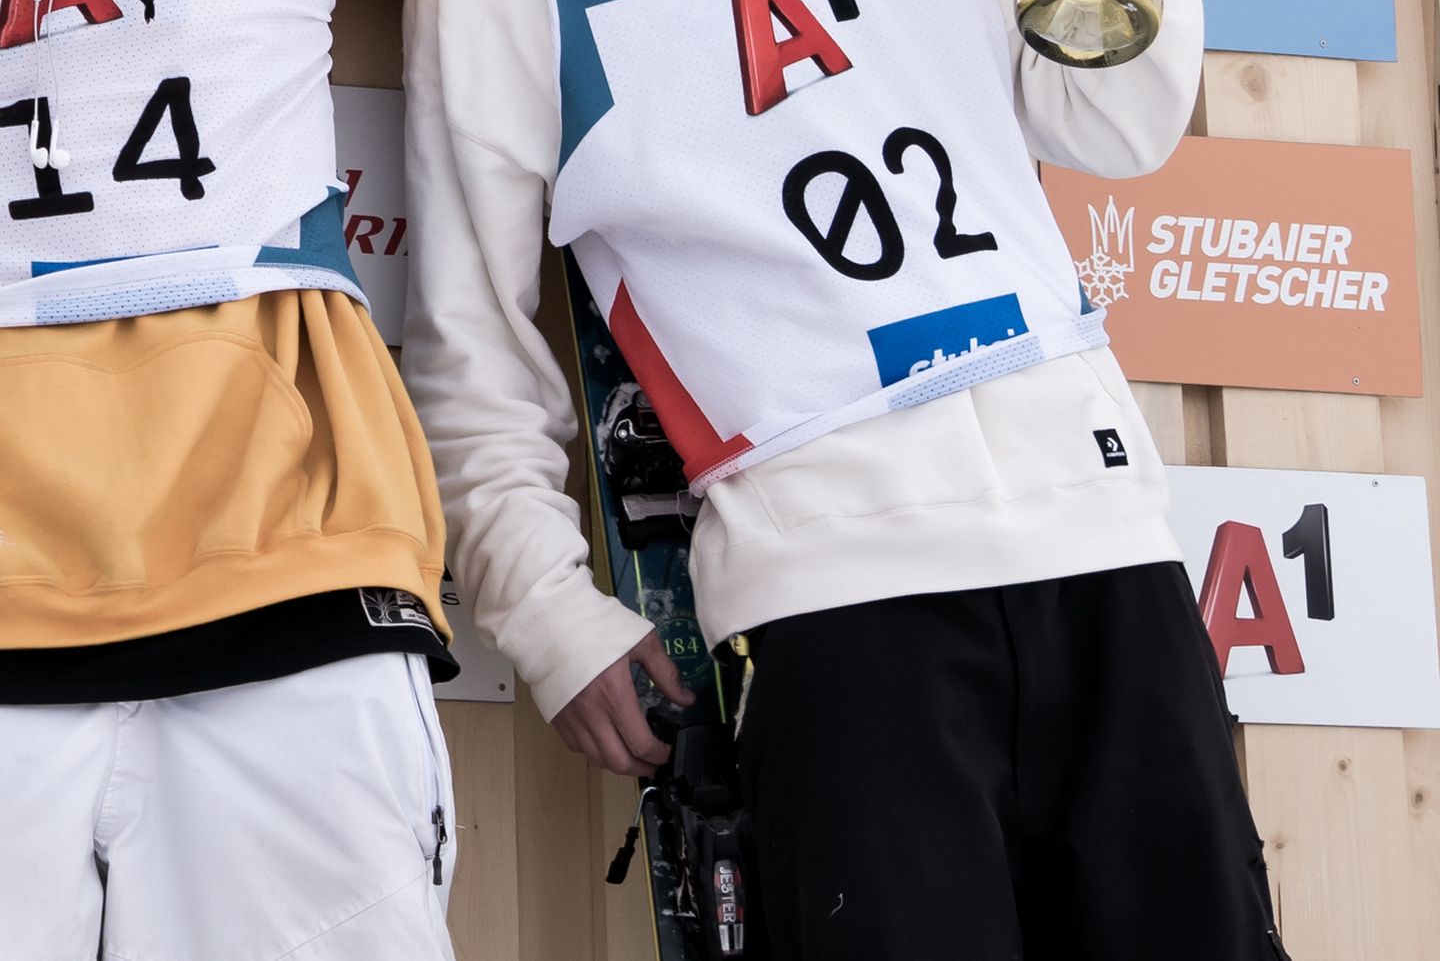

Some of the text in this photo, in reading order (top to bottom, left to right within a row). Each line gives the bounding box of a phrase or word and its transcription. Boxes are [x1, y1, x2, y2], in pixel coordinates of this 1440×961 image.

[781, 125, 998, 283] 02
[1145, 215, 1353, 266] STUBAIER
[1149, 261, 1389, 312] GLETSCHER
[1197, 503, 1335, 680] A1
[664, 636, 700, 655] 184
[719, 866, 737, 923] JESTER
